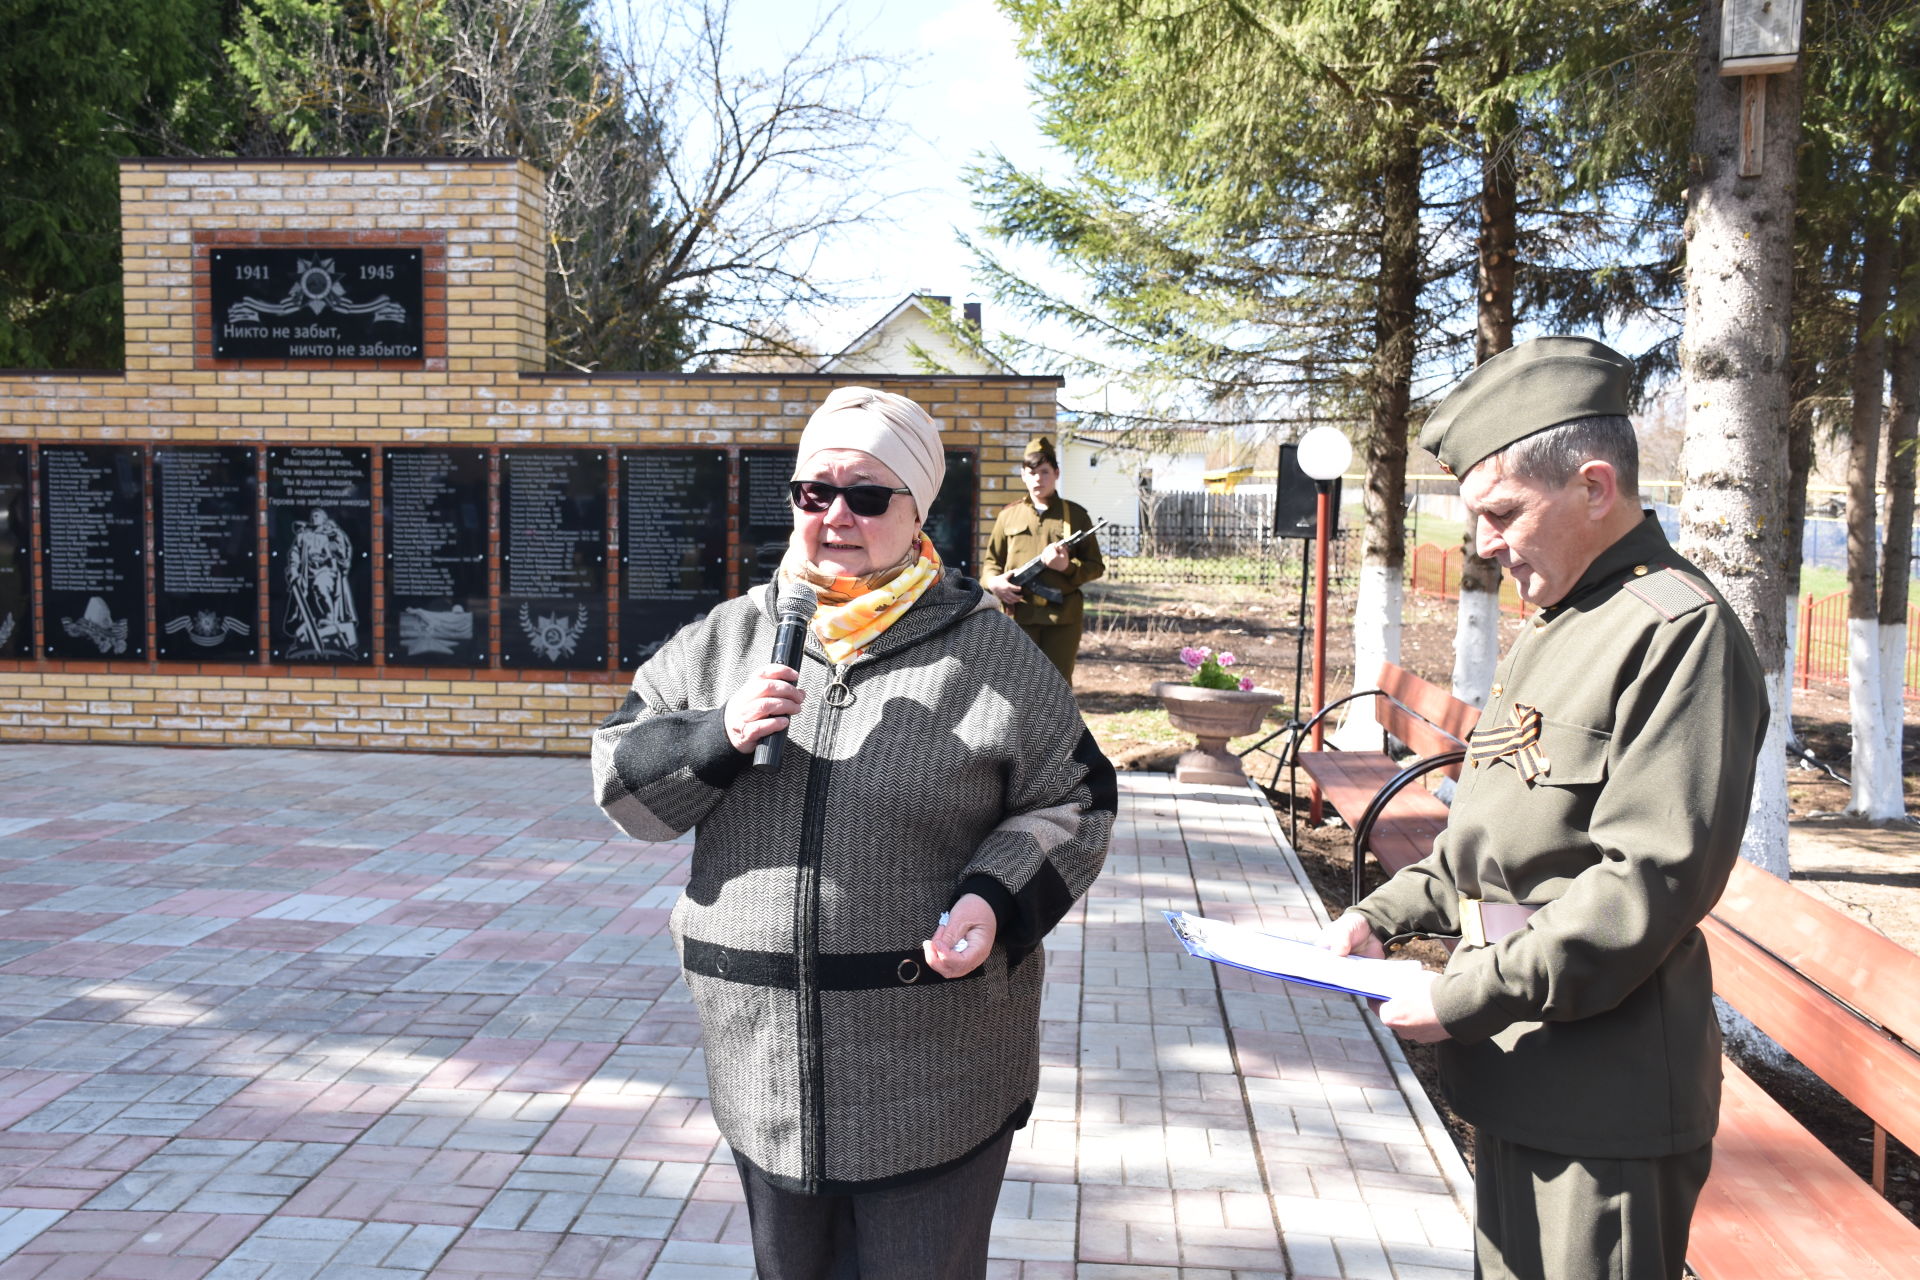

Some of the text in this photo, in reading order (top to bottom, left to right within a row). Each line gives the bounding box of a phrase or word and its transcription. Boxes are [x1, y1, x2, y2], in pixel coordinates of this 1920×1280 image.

[235, 265, 270, 280] 1941
[359, 265, 395, 280] 1945
[224, 323, 342, 340] Никто не забыт,
[289, 341, 412, 357] ничто не забыто
